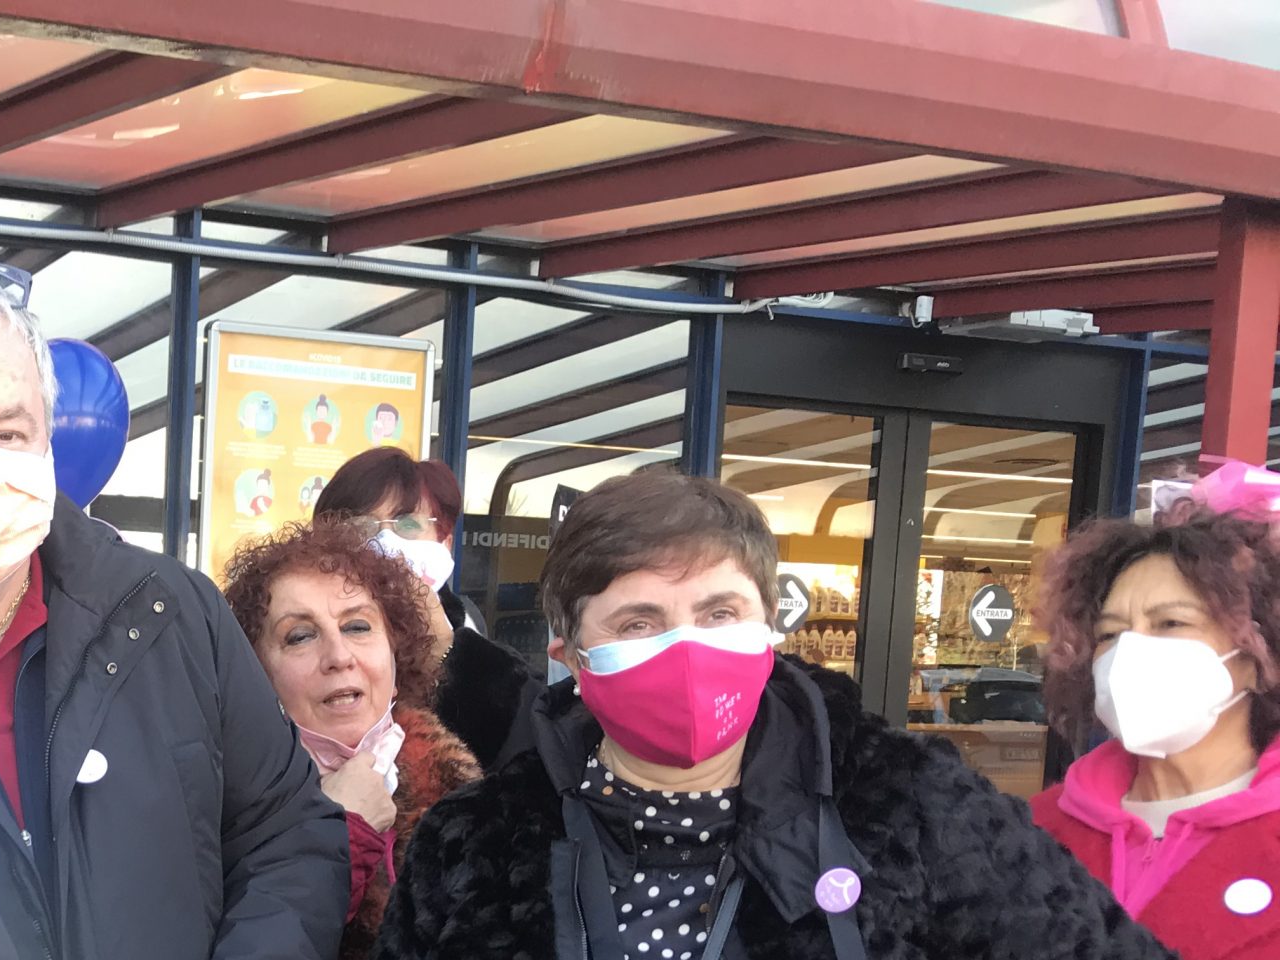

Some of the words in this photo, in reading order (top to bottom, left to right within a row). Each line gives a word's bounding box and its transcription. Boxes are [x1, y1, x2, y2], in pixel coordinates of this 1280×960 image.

[370, 371, 413, 387] SEGUIRE
[779, 599, 805, 610] TRATA
[976, 609, 1009, 619] ENTRATA
